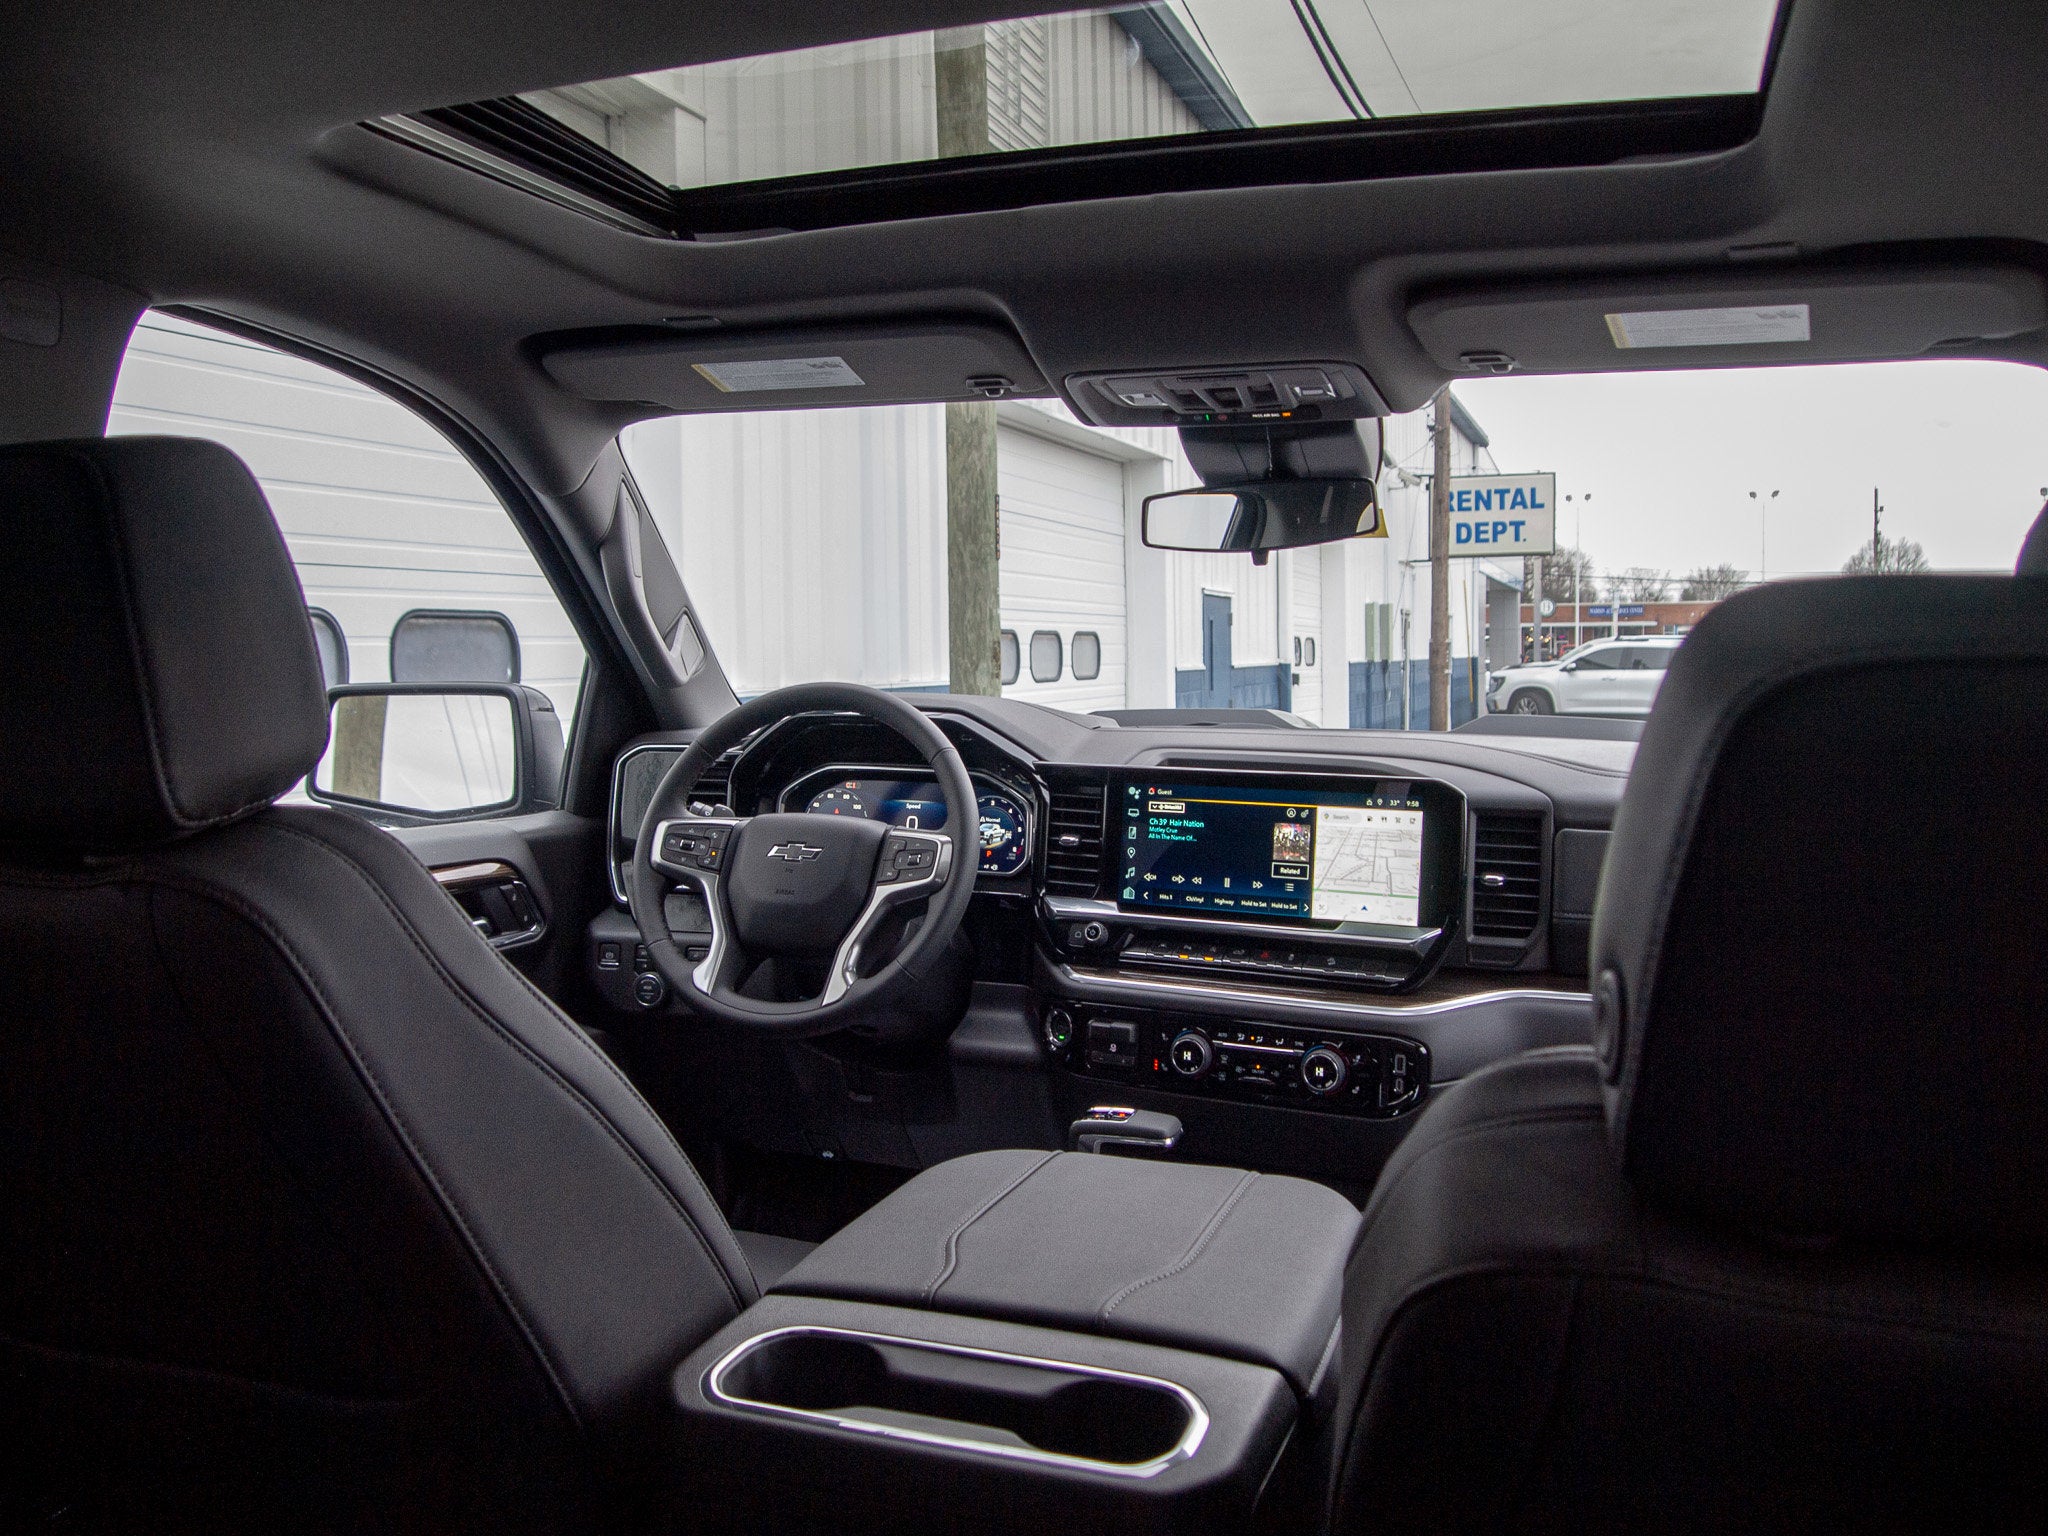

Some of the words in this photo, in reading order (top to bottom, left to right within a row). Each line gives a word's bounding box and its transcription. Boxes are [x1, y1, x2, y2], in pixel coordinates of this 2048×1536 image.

[1456, 520, 1527, 544] DEPT.
[1157, 788, 1173, 796] Guest
[1149, 817, 1158, 826] Ch
[1159, 818, 1168, 826] 39
[1169, 818, 1182, 827] Hair
[1183, 819, 1205, 828] Nation
[986, 849, 992, 857] P
[1280, 866, 1301, 875] Related
[1214, 897, 1235, 906] Highway
[1241, 899, 1254, 907] Hold
[1271, 901, 1284, 909] Hold
[1289, 903, 1298, 911] Set
[1183, 1051, 1192, 1061] HI
[1315, 1066, 1324, 1077] HI
